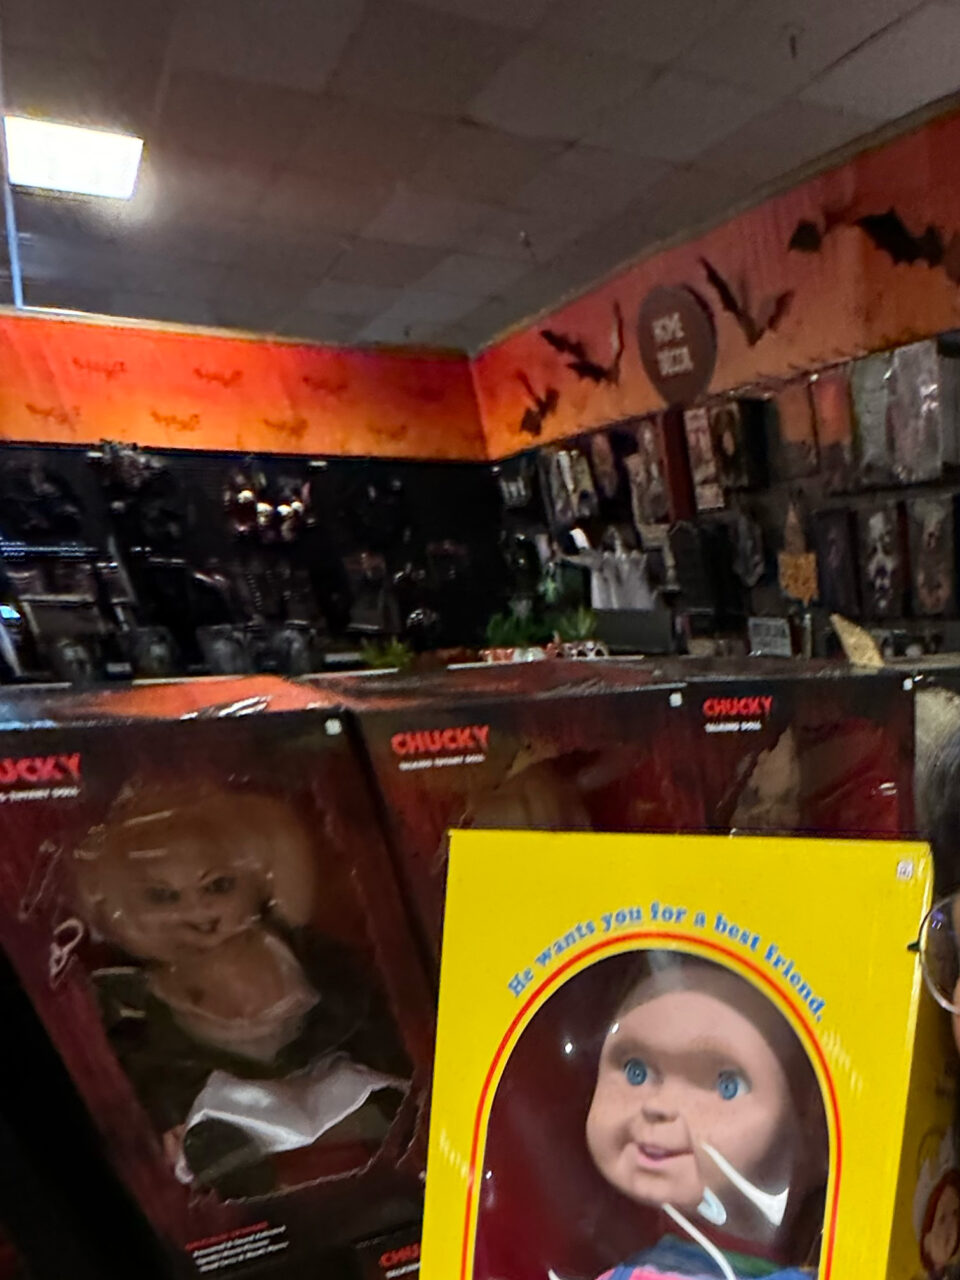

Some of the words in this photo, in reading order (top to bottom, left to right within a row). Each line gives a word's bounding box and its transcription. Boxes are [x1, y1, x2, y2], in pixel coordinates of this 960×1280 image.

[703, 695, 773, 718] CHUCKY
[390, 725, 489, 755] CHUCKY
[507, 968, 534, 998] He
[535, 920, 596, 966] wants
[601, 906, 642, 933] you
[650, 900, 687, 923] for
[693, 911, 706, 928] a
[714, 912, 761, 951] best
